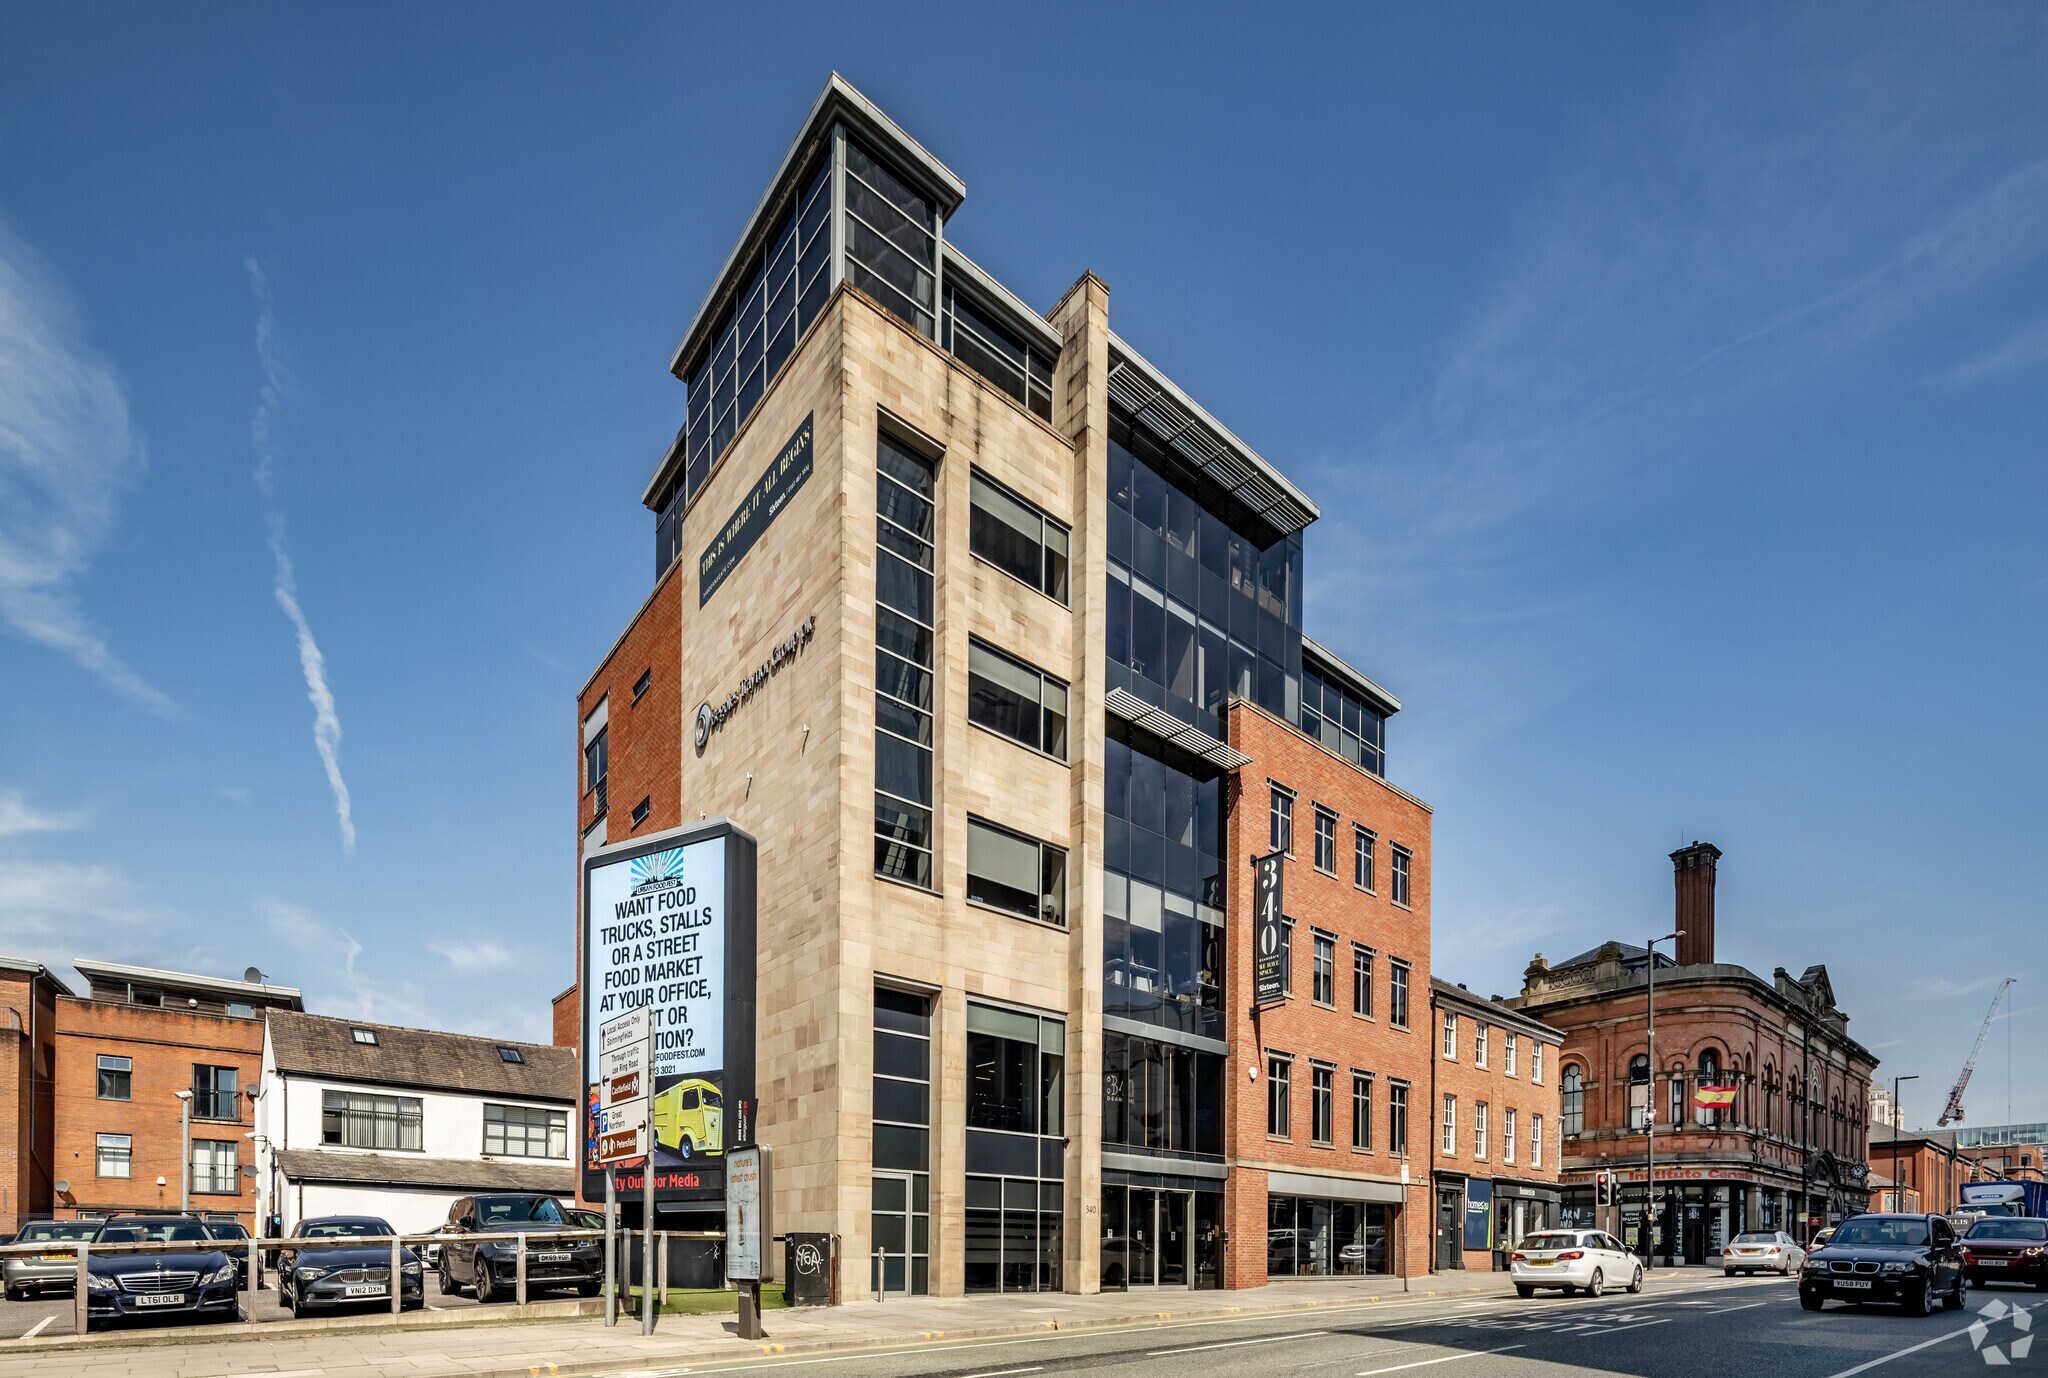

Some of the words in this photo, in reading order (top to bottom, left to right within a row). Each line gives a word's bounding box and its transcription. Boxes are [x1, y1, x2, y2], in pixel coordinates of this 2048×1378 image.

[702, 548, 717, 576] THIS
[718, 537, 725, 556] IS
[726, 502, 751, 544] WHERE
[752, 489, 761, 511] IT
[763, 470, 778, 498] ALL
[780, 426, 811, 476] BEGINS
[771, 631, 799, 668] Group
[637, 884, 653, 894] URBAN
[653, 881, 666, 890] FOOD
[666, 879, 676, 888] FEST
[615, 895, 654, 920] WANT
[658, 887, 696, 911] FOOD
[1261, 860, 1278, 956] 340
[601, 919, 656, 945] TRUCKS,
[660, 907, 712, 934] STALLS
[612, 946, 630, 966] OR
[633, 944, 643, 962] A
[646, 932, 699, 960] STREET
[605, 967, 640, 989] FOOD
[644, 956, 703, 983] MARKET
[600, 993, 616, 1012] AT
[619, 988, 654, 1009] YOUR
[659, 979, 711, 1003] OFFICE,
[668, 1006, 687, 1026] OR
[607, 1024, 617, 1035] Local
[617, 1019, 631, 1030] Access
[631, 1015, 641, 1025] Only
[607, 1030, 633, 1046] Spinningfields
[655, 1028, 694, 1051] TION?
[611, 1051, 626, 1063] Through
[627, 1046, 639, 1058] traffic
[655, 1048, 706, 1062] FOODFEST.COM
[619, 1062, 628, 1071] Ring
[629, 1058, 639, 1069] Road
[661, 1065, 676, 1075] 3021
[611, 1082, 631, 1096] Castlefield
[612, 1110, 623, 1120] Great
[609, 1120, 625, 1130] Northern
[616, 1137, 636, 1149] Petersfield
[615, 1177, 625, 1191] ty
[627, 1175, 667, 1189] Outoor
[669, 1173, 699, 1187] Media
[1560, 1176, 1590, 1184] anish
[1629, 1169, 1702, 1181] Instituto
[1708, 1169, 1754, 1181] Cervantes
[1085, 1205, 1097, 1214] 340
[351, 1286, 367, 1295] VN12
[368, 1285, 383, 1294] DXH
[141, 1296, 160, 1305] LT61
[162, 1295, 180, 1304] OLR
